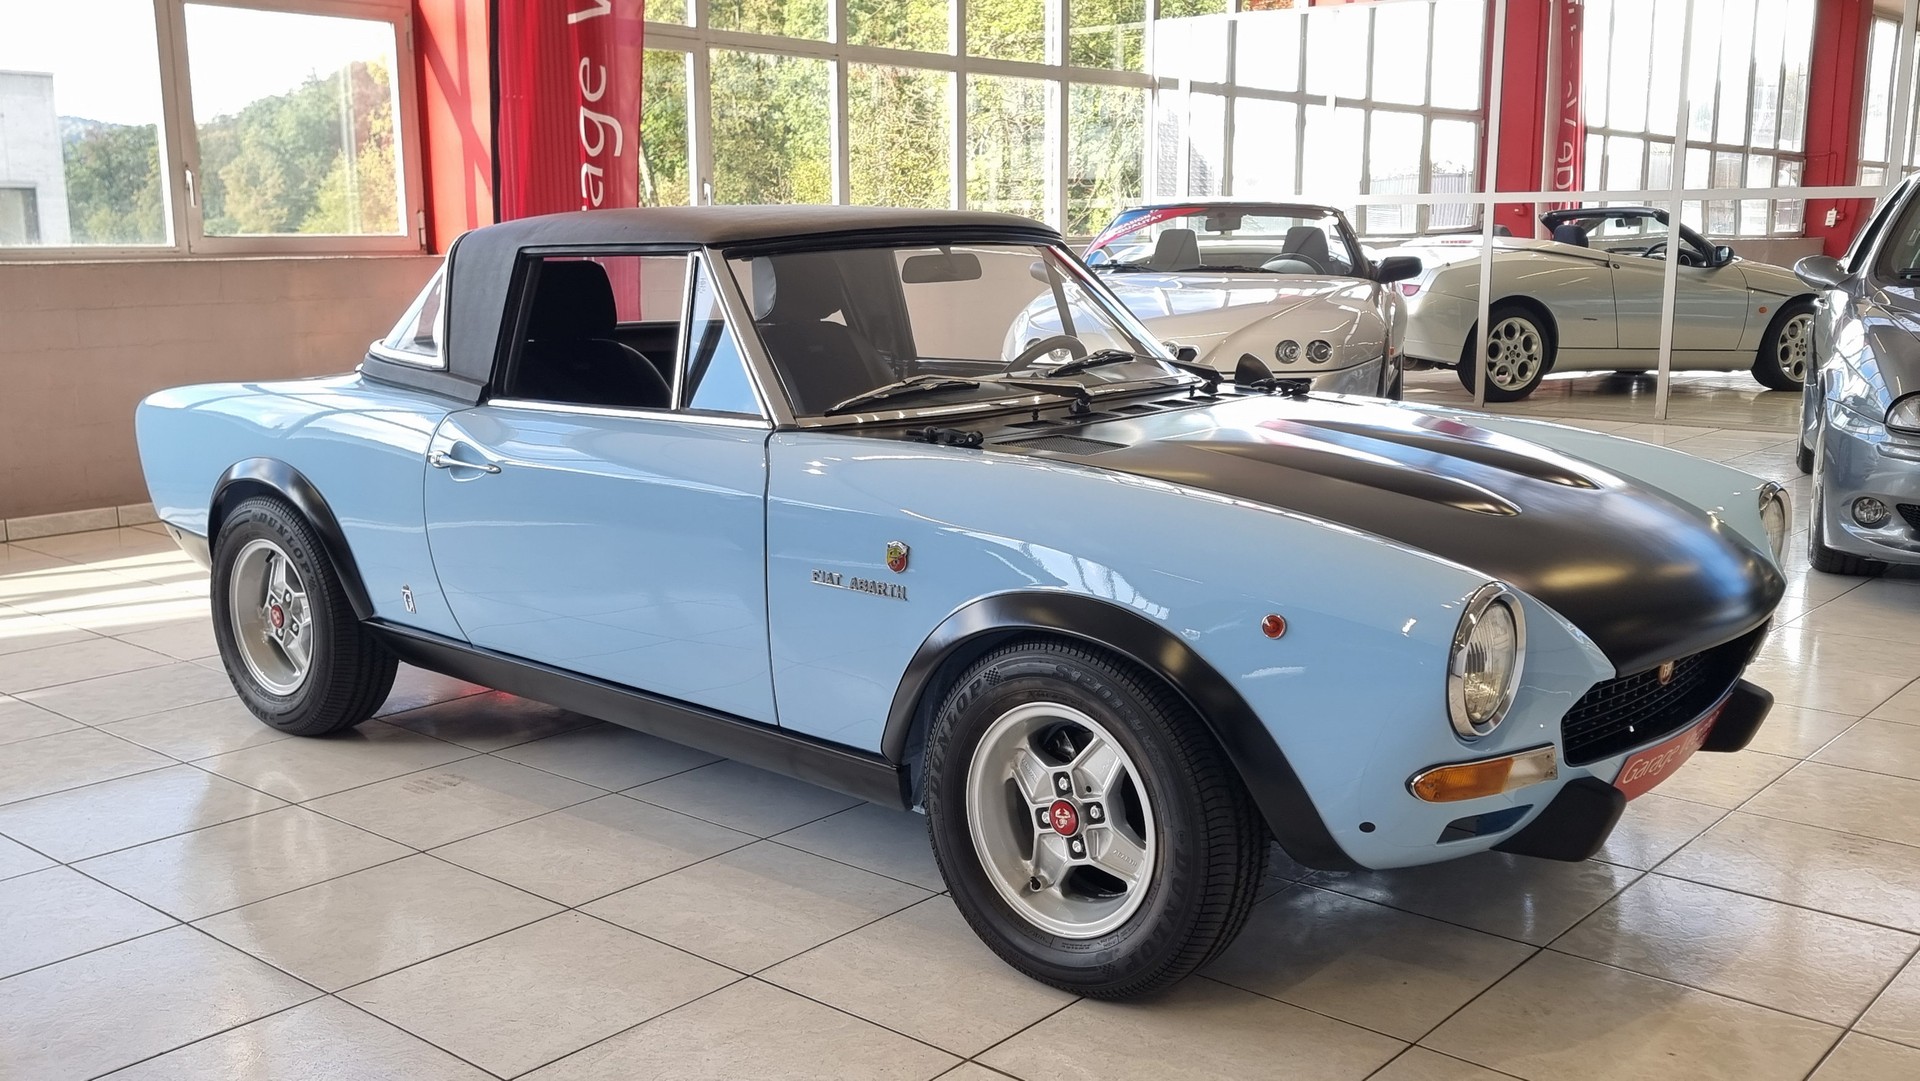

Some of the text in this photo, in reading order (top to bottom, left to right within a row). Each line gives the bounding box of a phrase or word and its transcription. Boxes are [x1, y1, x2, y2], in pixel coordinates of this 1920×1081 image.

[257, 511, 312, 574] DUNLOP
[811, 569, 908, 601] FIAT ABARTH
[928, 677, 984, 798] DUNLOP
[1622, 744, 1681, 784] Garage
